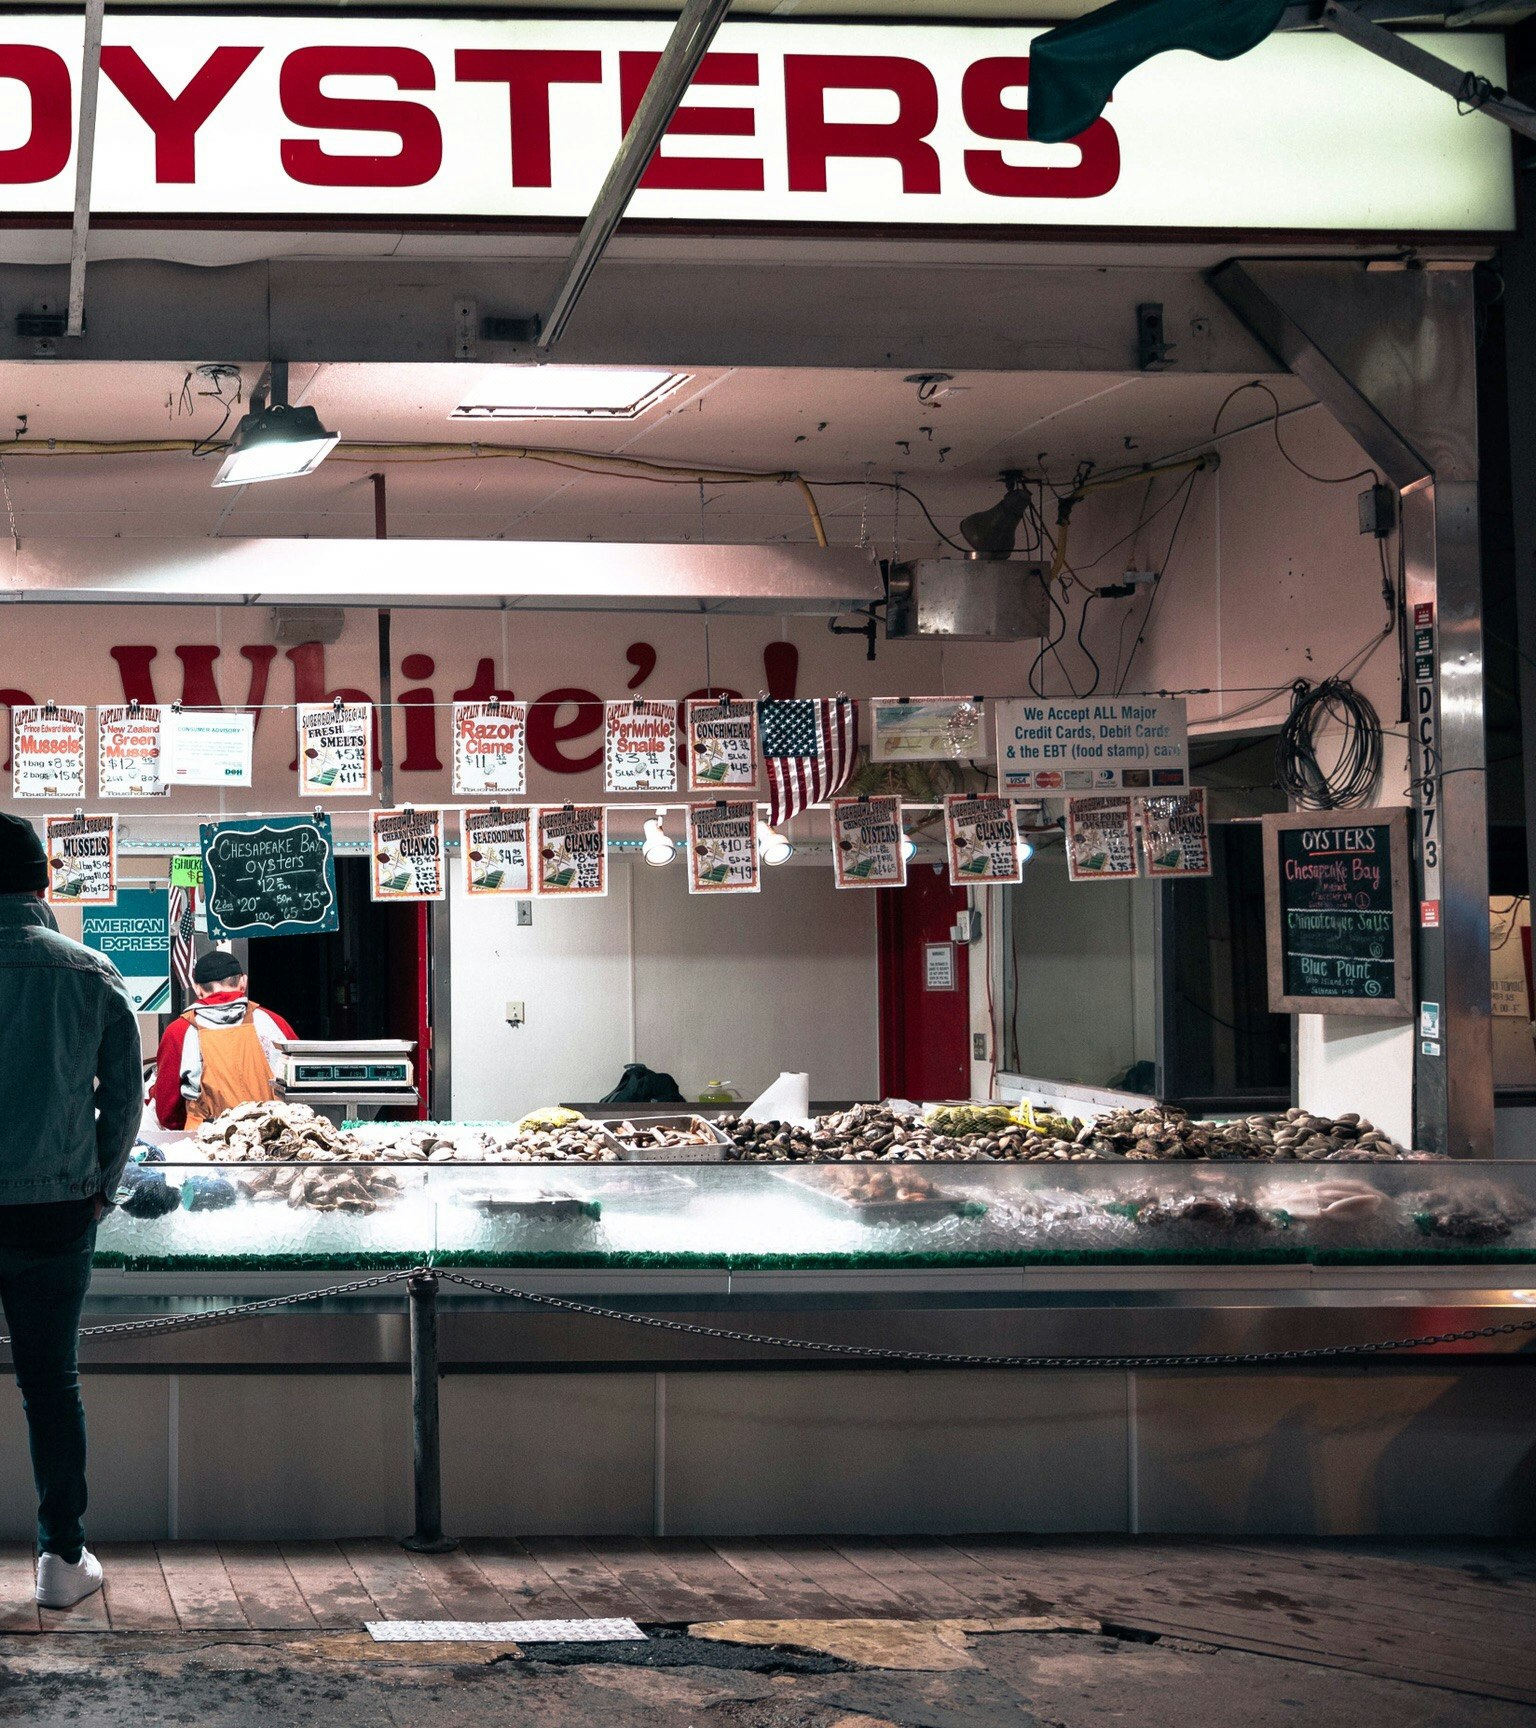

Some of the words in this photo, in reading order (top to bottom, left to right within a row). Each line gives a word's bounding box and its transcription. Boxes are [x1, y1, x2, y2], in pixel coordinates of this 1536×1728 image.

[14, 709, 37, 727] CAPTAIN
[1023, 707, 1044, 721] We
[1047, 707, 1090, 723] Accept
[1093, 706, 1117, 719] ALL
[1121, 705, 1157, 721] Major
[23, 725, 41, 733] Prince
[41, 725, 60, 733] Edward
[61, 725, 76, 733] Island
[107, 725, 125, 733] New
[126, 724, 160, 734] Zealand
[308, 725, 343, 738] FRESH
[460, 720, 519, 739] Razor
[611, 718, 671, 738] Periwinkle
[696, 723, 724, 740] CONCH
[725, 722, 752, 738] MEAT
[1014, 725, 1052, 740] Credit
[1055, 725, 1095, 741] Cards,
[1099, 724, 1131, 738] Debit
[1135, 724, 1170, 738] Cards
[20, 735, 79, 754] Mussels
[112, 733, 156, 746] Green
[320, 735, 365, 748] SMELTS
[465, 740, 514, 754] Clams
[617, 737, 665, 753] Snails
[106, 746, 160, 758] Musse
[1005, 746, 1015, 759] &
[1019, 745, 1039, 758] the
[1043, 744, 1067, 758] EBT
[1071, 743, 1103, 760] (food
[1106, 743, 1149, 760] stamp)
[28, 760, 44, 768] bag
[29, 771, 49, 781] bags
[19, 790, 81, 798] Touchdown!
[462, 785, 521, 793] Touchdown!
[1074, 812, 1100, 822] BLUE
[1100, 811, 1128, 821] POINT
[1082, 820, 1123, 830] OYSTERS
[1168, 815, 1204, 835] CLAMS
[473, 830, 508, 844] SEAFOOD
[697, 823, 722, 839] BLACK
[723, 821, 750, 838] CLAMS
[861, 824, 898, 844] OYSTERS
[975, 820, 1012, 841] CLAMS
[63, 837, 109, 857] MUSSELS
[399, 836, 436, 857] CLAMS
[564, 833, 602, 853] CLAMS
[1302, 828, 1375, 850] OYSTERS
[218, 838, 294, 861] CHESAPEAKE
[245, 854, 304, 881] oysters
[1352, 858, 1380, 889] Bay
[84, 919, 164, 933] AMERICAN
[100, 936, 170, 951] EXPRESS
[1300, 957, 1327, 976] Blue
[1336, 960, 1371, 979] Point
